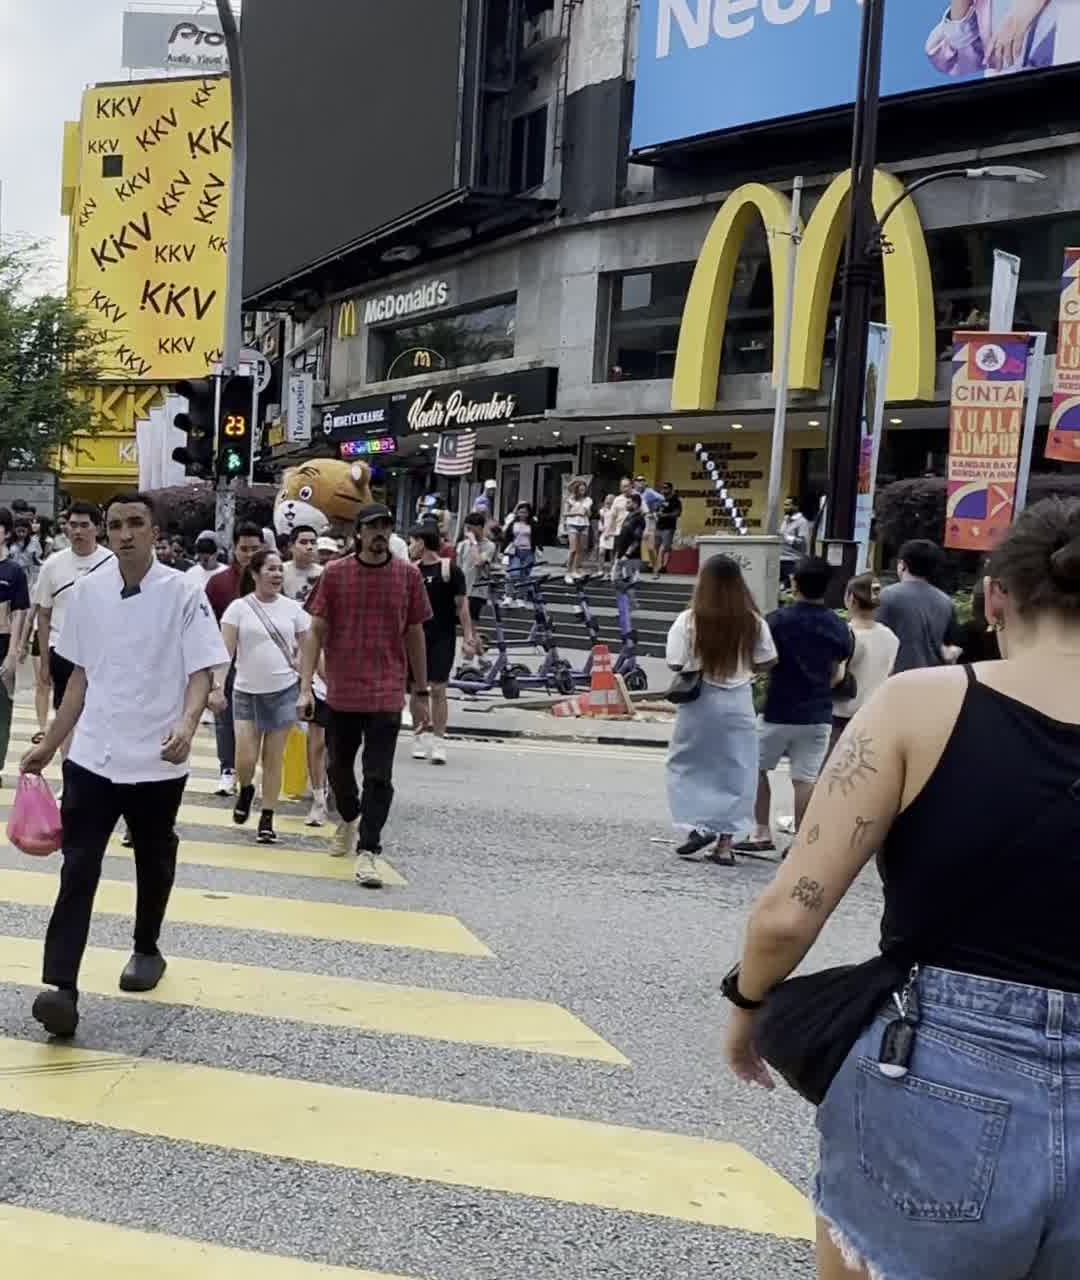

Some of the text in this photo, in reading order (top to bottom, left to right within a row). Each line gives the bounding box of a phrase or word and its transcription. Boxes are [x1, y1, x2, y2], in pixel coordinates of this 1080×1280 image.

[97, 96, 142, 119] KKV
[136, 107, 178, 152] KKV
[88, 139, 119, 154] KKV
[115, 166, 152, 201] KKV
[157, 169, 192, 216] KKV
[193, 172, 225, 225] KKV
[90, 211, 152, 272] KKV
[154, 243, 196, 263] KKV
[89, 290, 127, 323] KKV
[139, 279, 217, 321] KKV
[363, 280, 449, 324] McDonald's
[114, 343, 153, 376] KKV
[158, 336, 196, 355] KKV
[955, 385, 1017, 402] CINTA
[224, 415, 245, 436] 23
[954, 409, 1019, 432] KUALA
